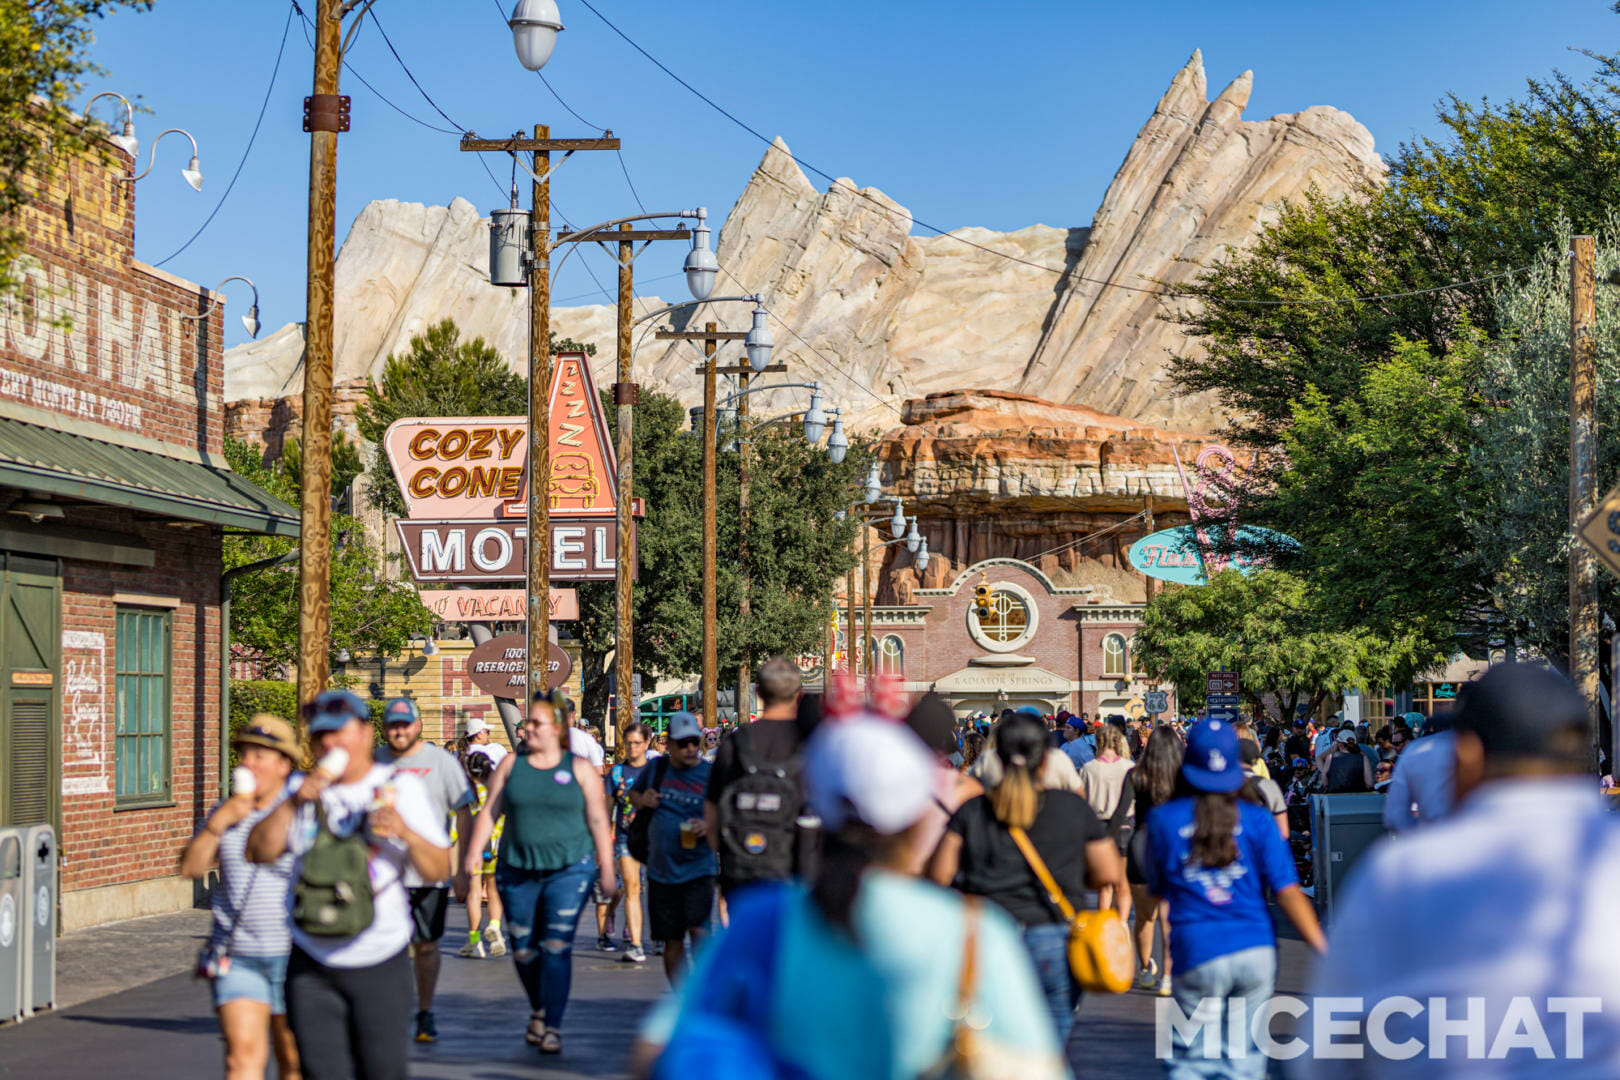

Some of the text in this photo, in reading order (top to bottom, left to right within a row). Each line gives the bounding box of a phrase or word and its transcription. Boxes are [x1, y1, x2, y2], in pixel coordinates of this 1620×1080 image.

[78, 390, 97, 418] AT
[409, 428, 524, 460] COZY
[409, 465, 524, 498] CONE
[420, 527, 616, 572] MOEL
[457, 595, 562, 617] VACANY
